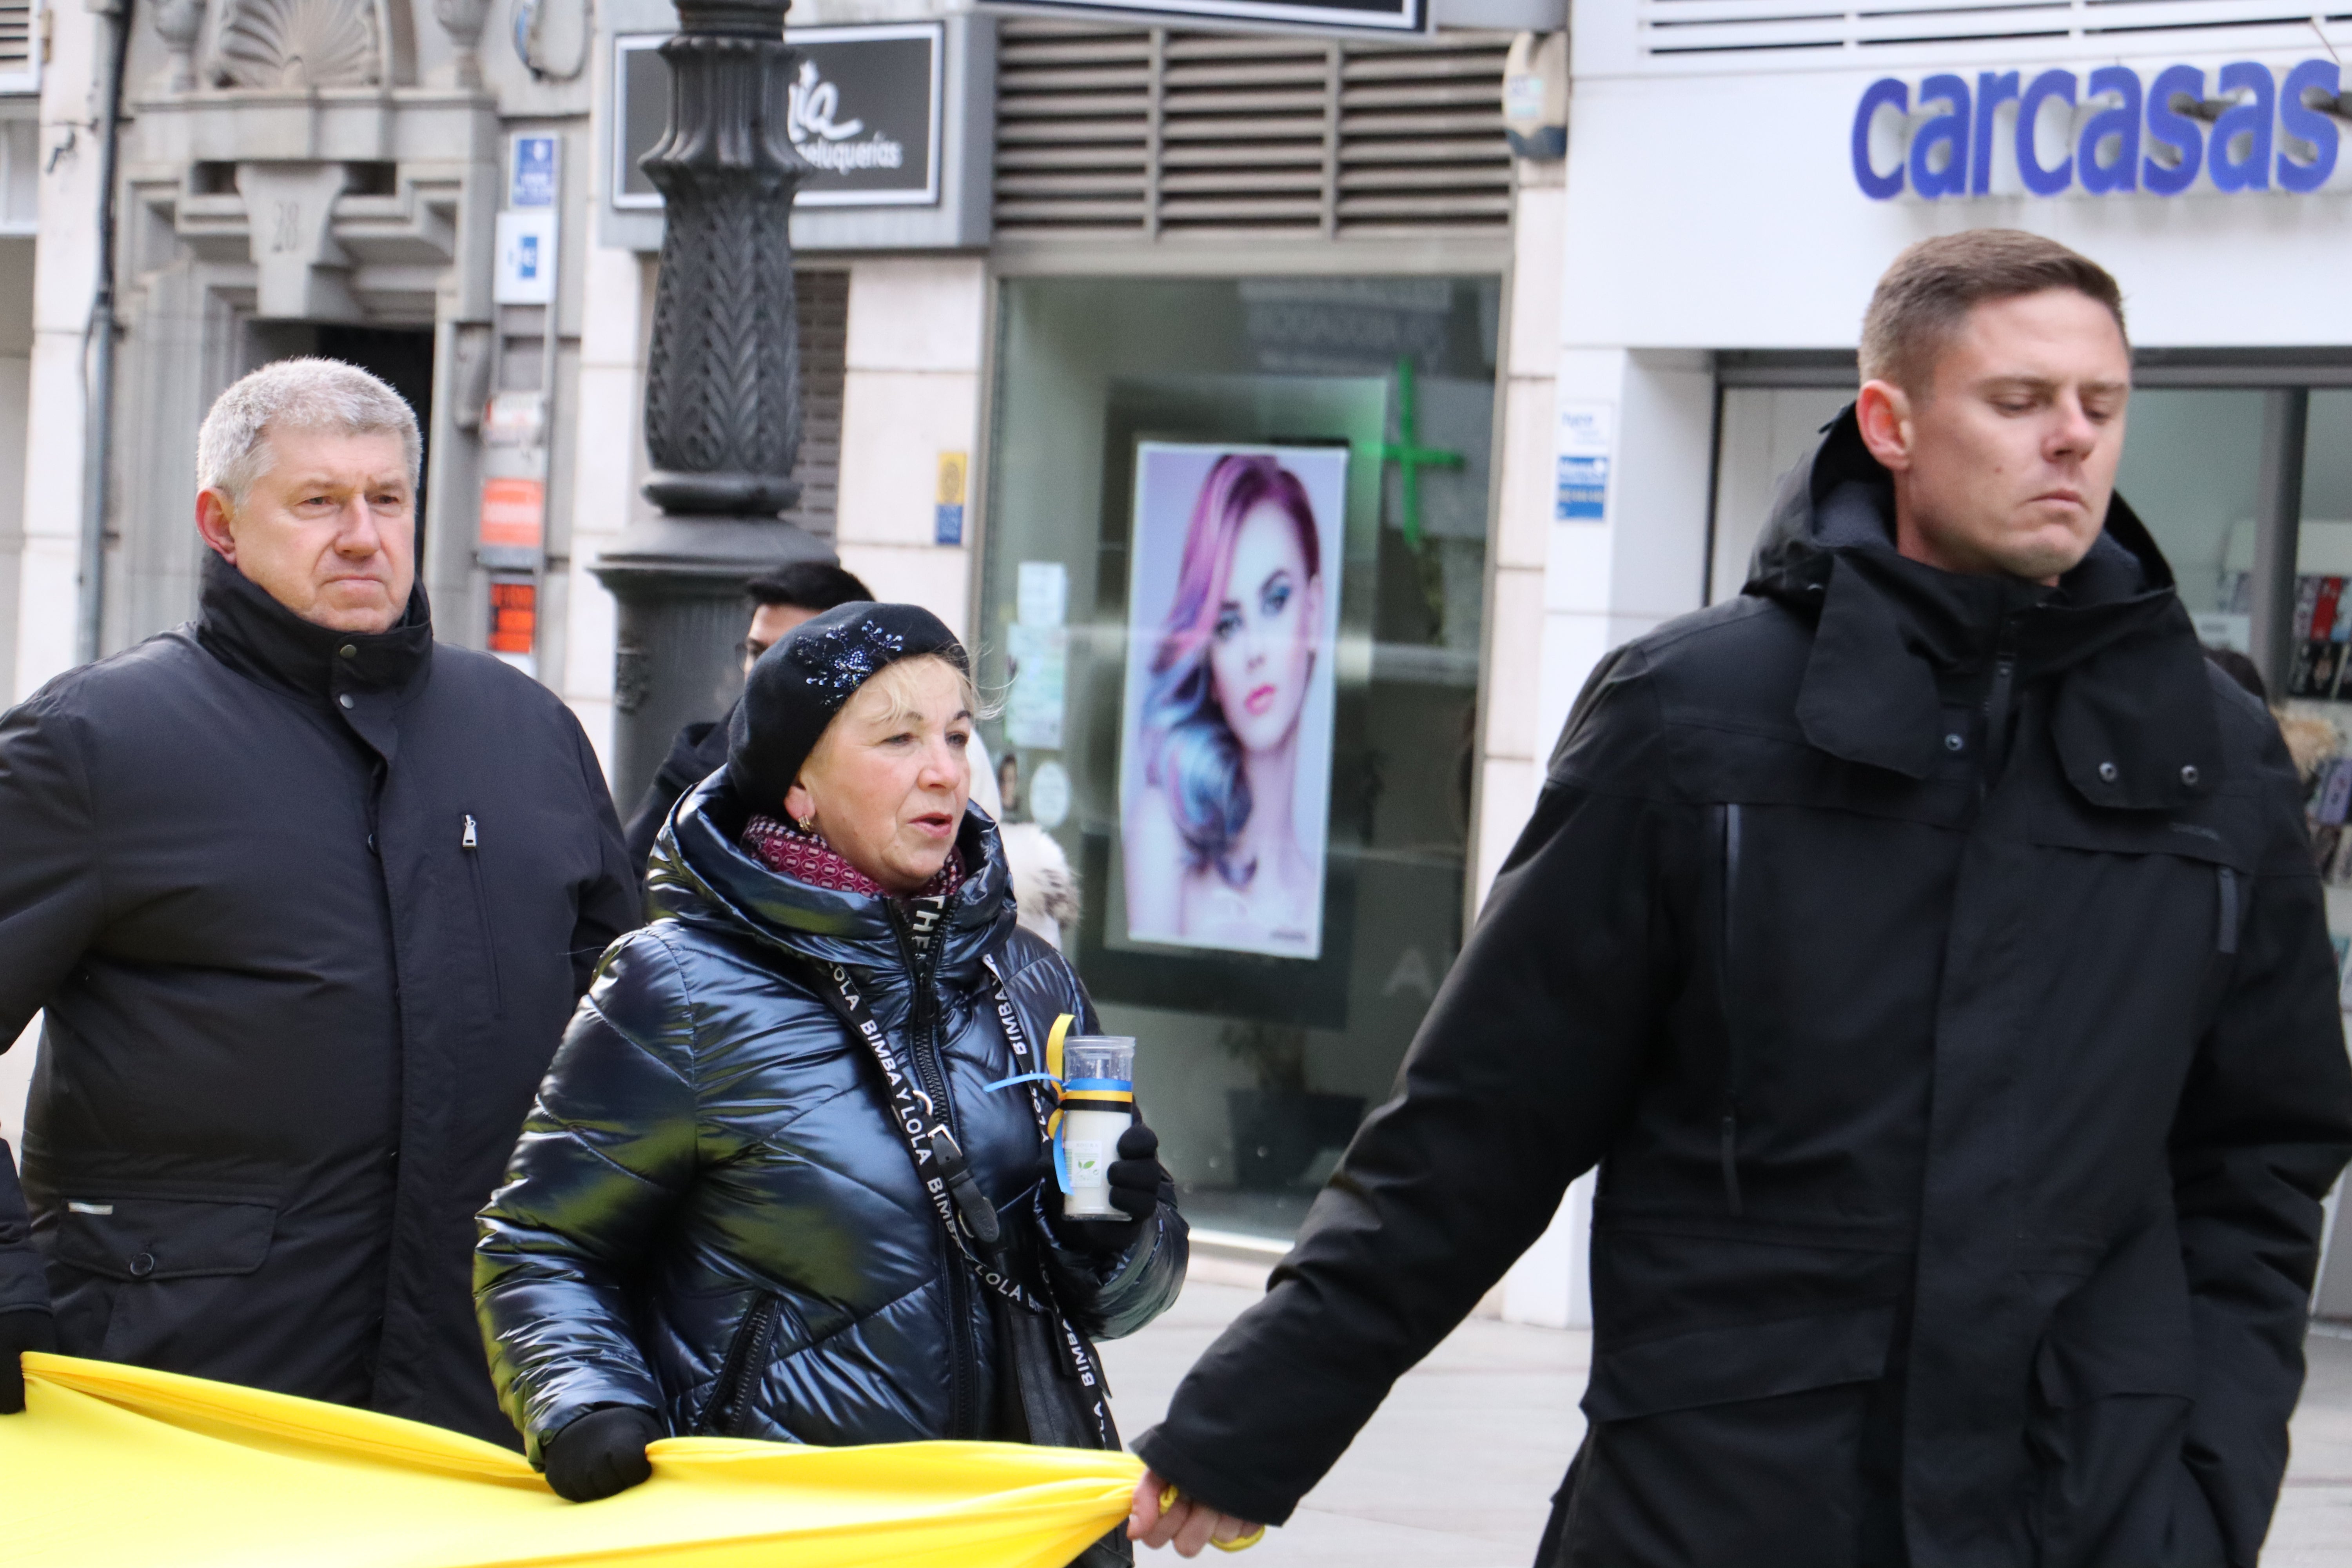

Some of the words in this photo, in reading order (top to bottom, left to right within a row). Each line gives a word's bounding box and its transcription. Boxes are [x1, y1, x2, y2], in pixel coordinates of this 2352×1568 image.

[1851, 59, 2340, 200] carcasas
[829, 962, 860, 1011] OLA
[995, 987, 1027, 1055] BIMBA
[860, 1019, 902, 1087] BIMBA
[896, 1087, 911, 1101] Y
[900, 1106, 932, 1165] LOLA
[975, 1265, 1021, 1301] LOLA
